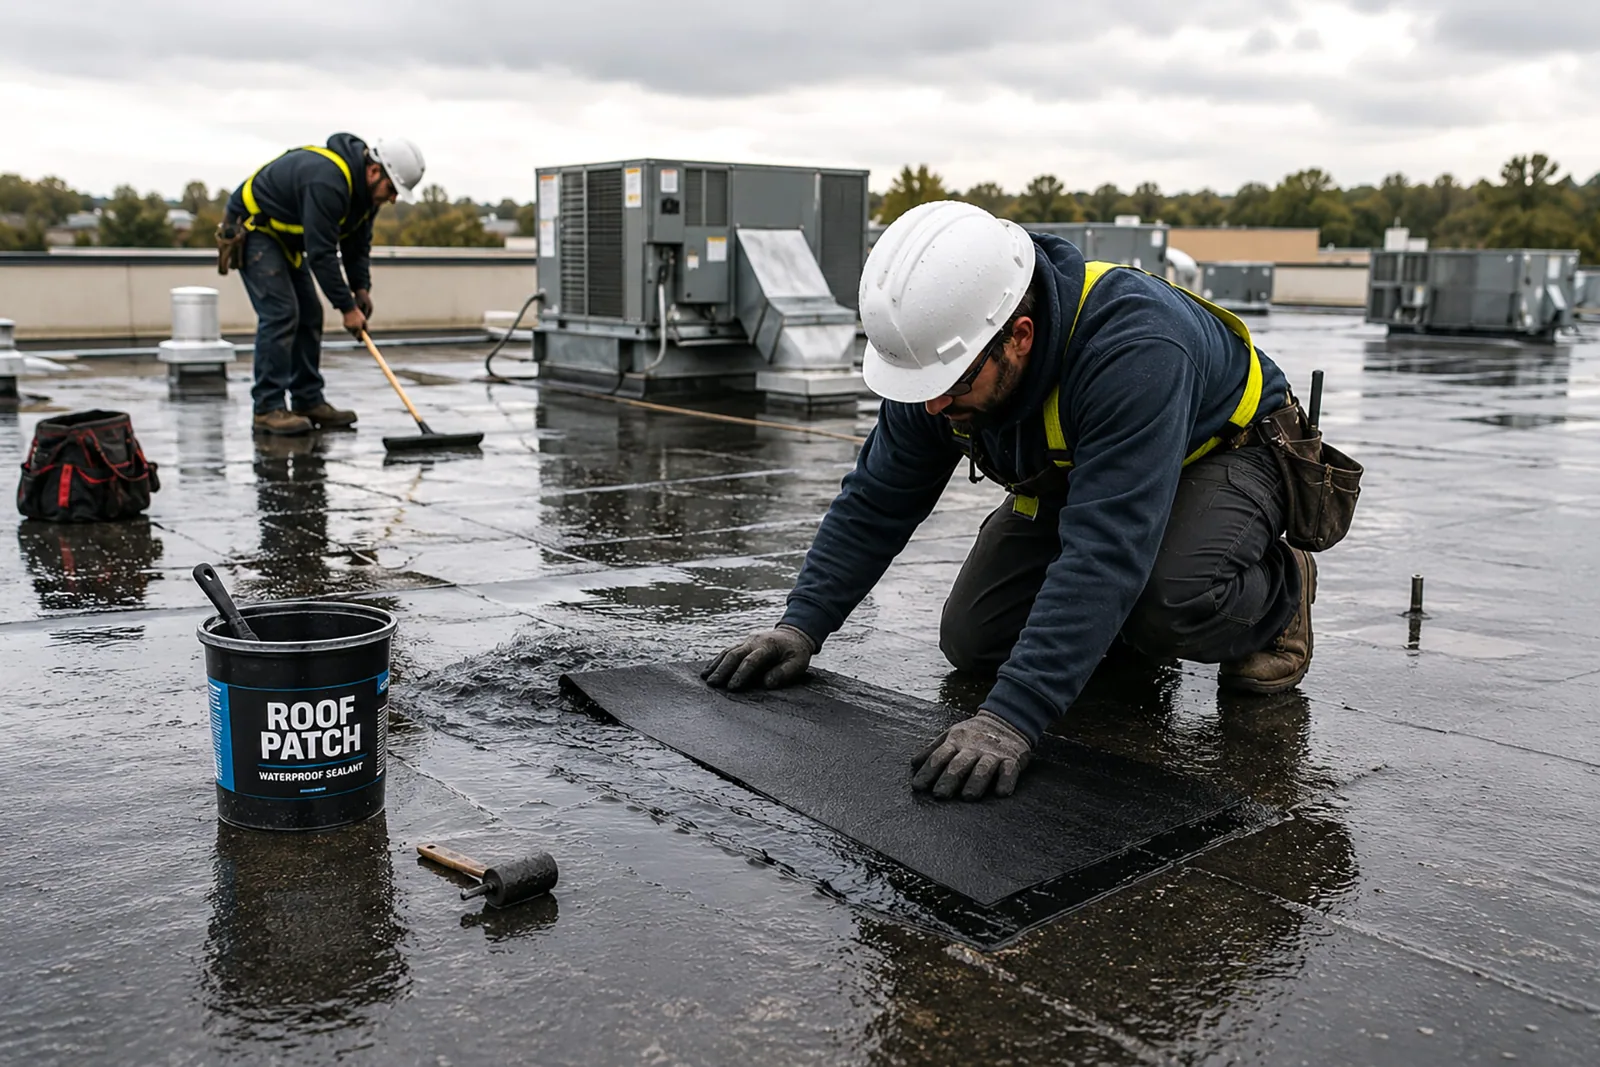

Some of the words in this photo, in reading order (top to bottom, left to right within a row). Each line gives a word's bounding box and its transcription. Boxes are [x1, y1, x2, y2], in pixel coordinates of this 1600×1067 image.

[267, 695, 355, 730] ROOF
[260, 723, 361, 760] PATCH
[259, 771, 324, 781] WATERPROOF
[326, 762, 363, 778] SEALANT
